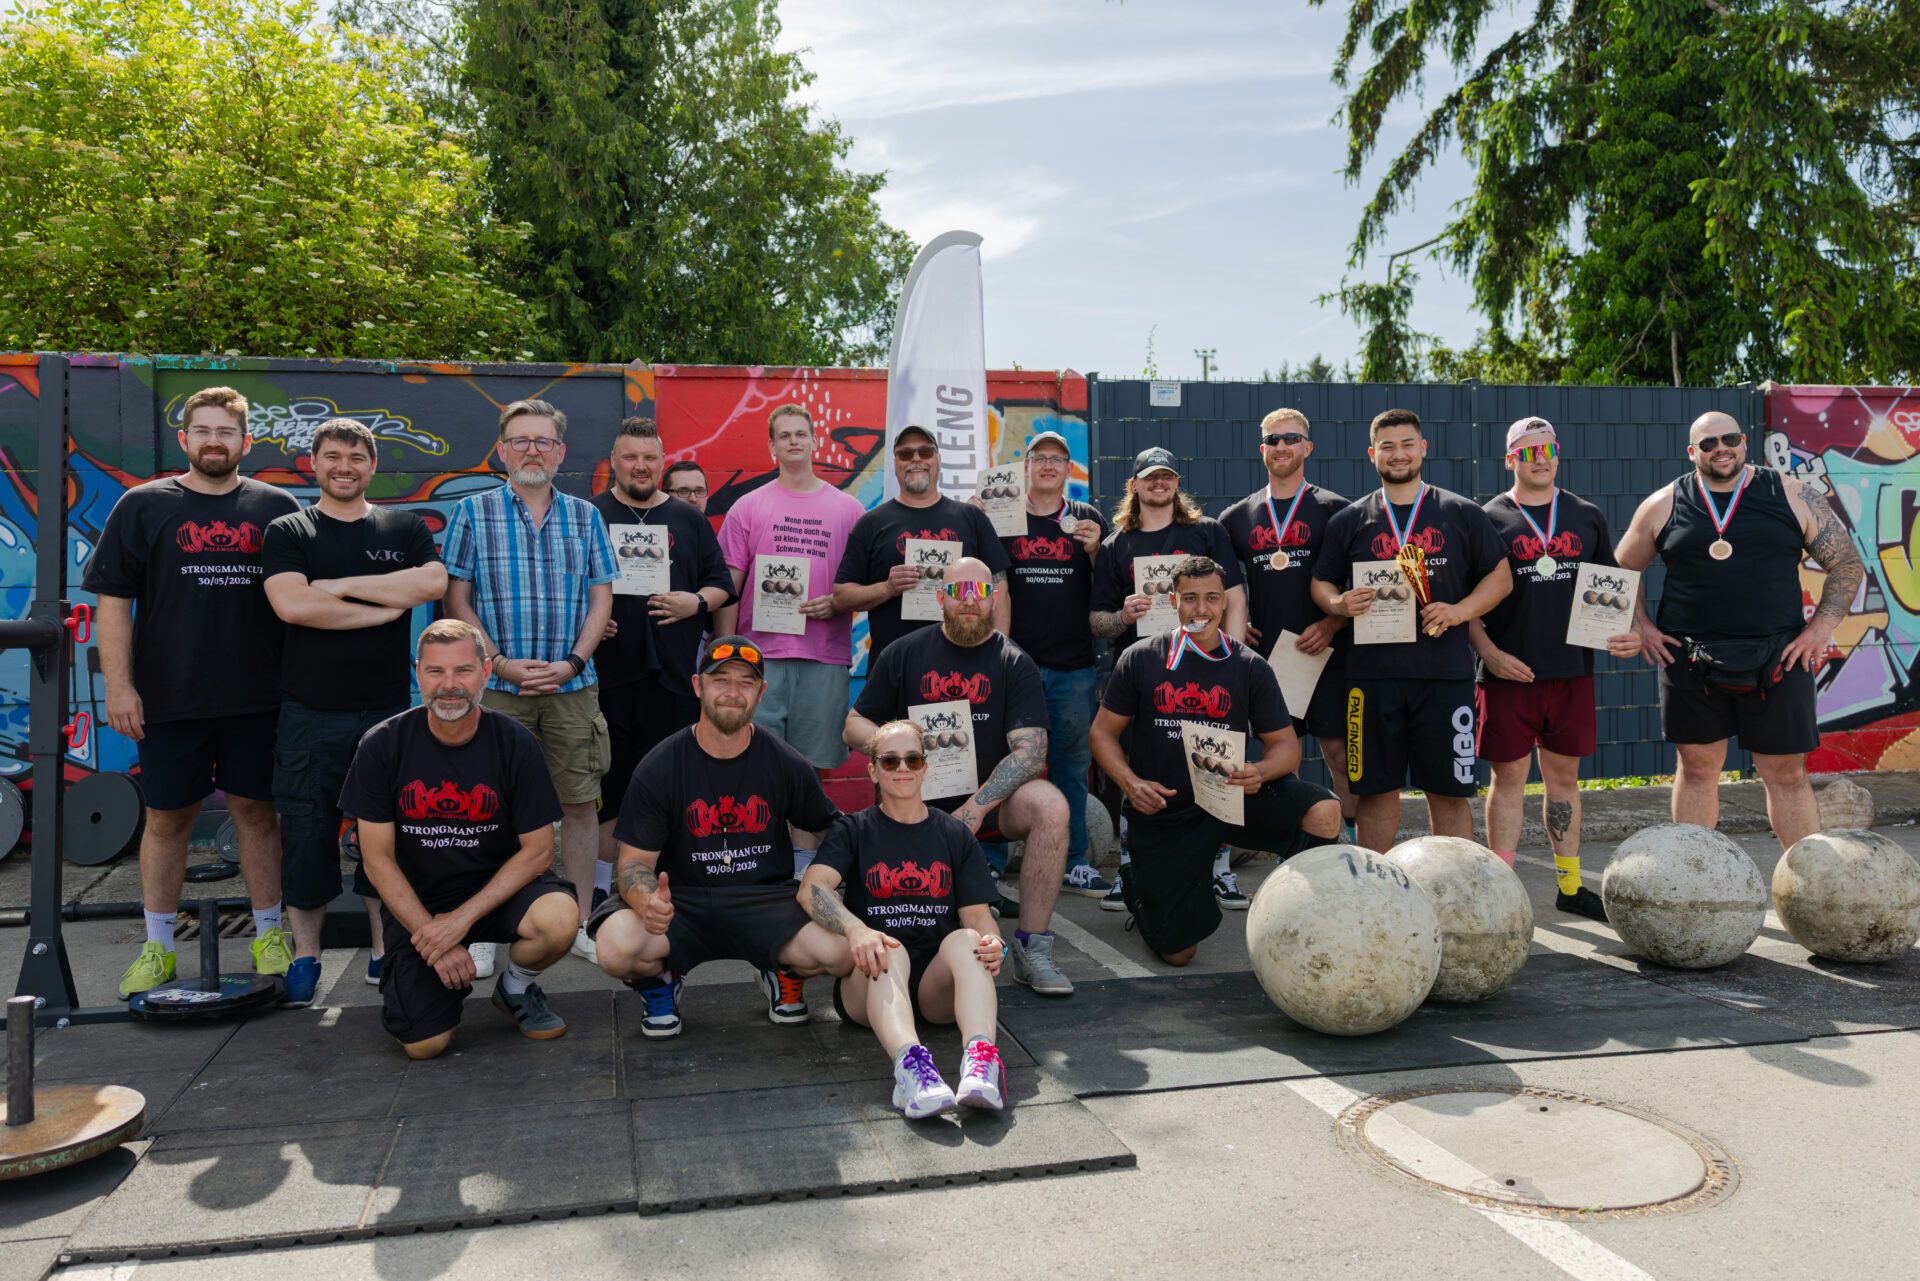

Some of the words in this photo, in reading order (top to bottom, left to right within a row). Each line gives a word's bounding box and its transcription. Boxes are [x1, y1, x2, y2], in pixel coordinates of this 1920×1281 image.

[802, 518, 822, 526] meine
[773, 524, 803, 534] Probleme
[803, 527, 820, 536] doch
[821, 530, 832, 538] nur
[783, 535, 800, 544] klein
[813, 539, 829, 549] mein
[775, 545, 804, 554] Schwanz
[806, 549, 826, 559] wären
[1252, 550, 1296, 564] STROAN
[1429, 558, 1447, 566] CUP
[1516, 561, 1567, 575] STROAN
[1568, 561, 1579, 569] CU
[181, 565, 246, 575] STRONGMAN
[1015, 567, 1059, 575] STRONGMAN
[1060, 567, 1074, 575] CUP
[198, 576, 251, 586] 30/05/2026
[1025, 576, 1064, 584] 30/05/2026
[1531, 571, 1572, 583] 30/05/202
[972, 713, 990, 721] CUP
[1154, 718, 1209, 728] STRONMAN
[1210, 722, 1230, 731] CUP
[1349, 695, 1361, 774] PALFINGER
[1451, 705, 1475, 784] FIBO
[402, 824, 474, 836] STRONGMAN
[475, 823, 499, 834] CUP
[420, 836, 480, 849] 30/05/2026
[691, 846, 751, 861] STRONGMAN
[751, 844, 771, 855] CUP
[706, 859, 757, 876] 30/05/2026
[867, 903, 933, 916] STRONGMAN
[885, 915, 937, 928] 30/05/2026
